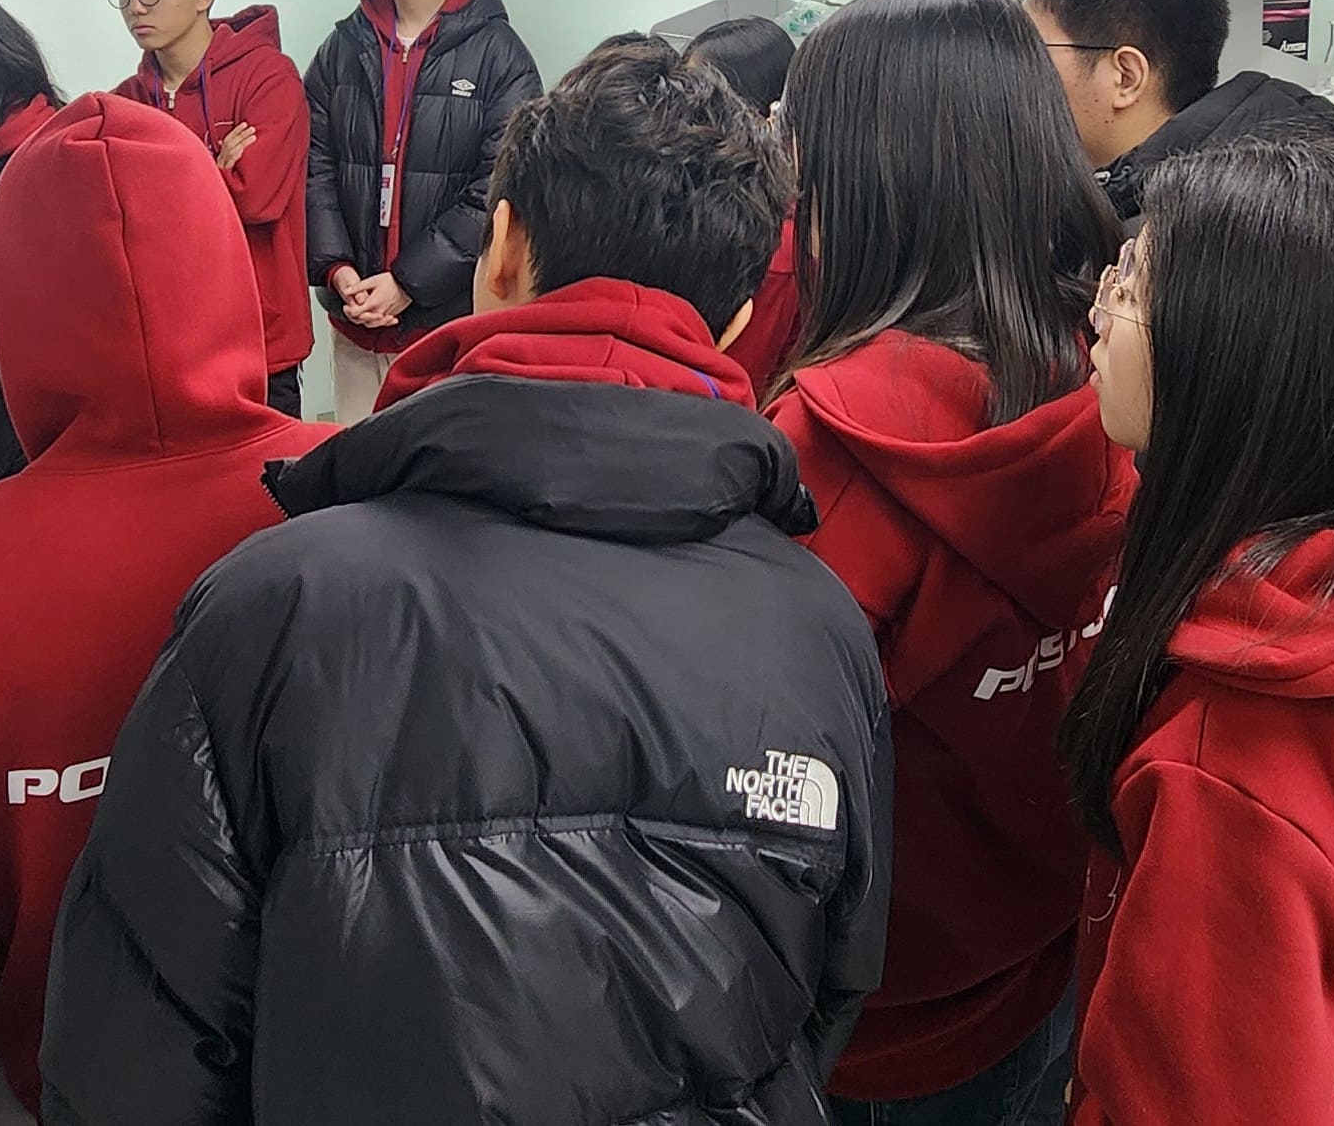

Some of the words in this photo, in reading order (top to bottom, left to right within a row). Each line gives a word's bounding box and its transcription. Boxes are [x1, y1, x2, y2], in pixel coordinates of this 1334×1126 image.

[765, 750, 810, 779] THE
[725, 767, 805, 803] NORTH
[745, 793, 801, 824] FACE
